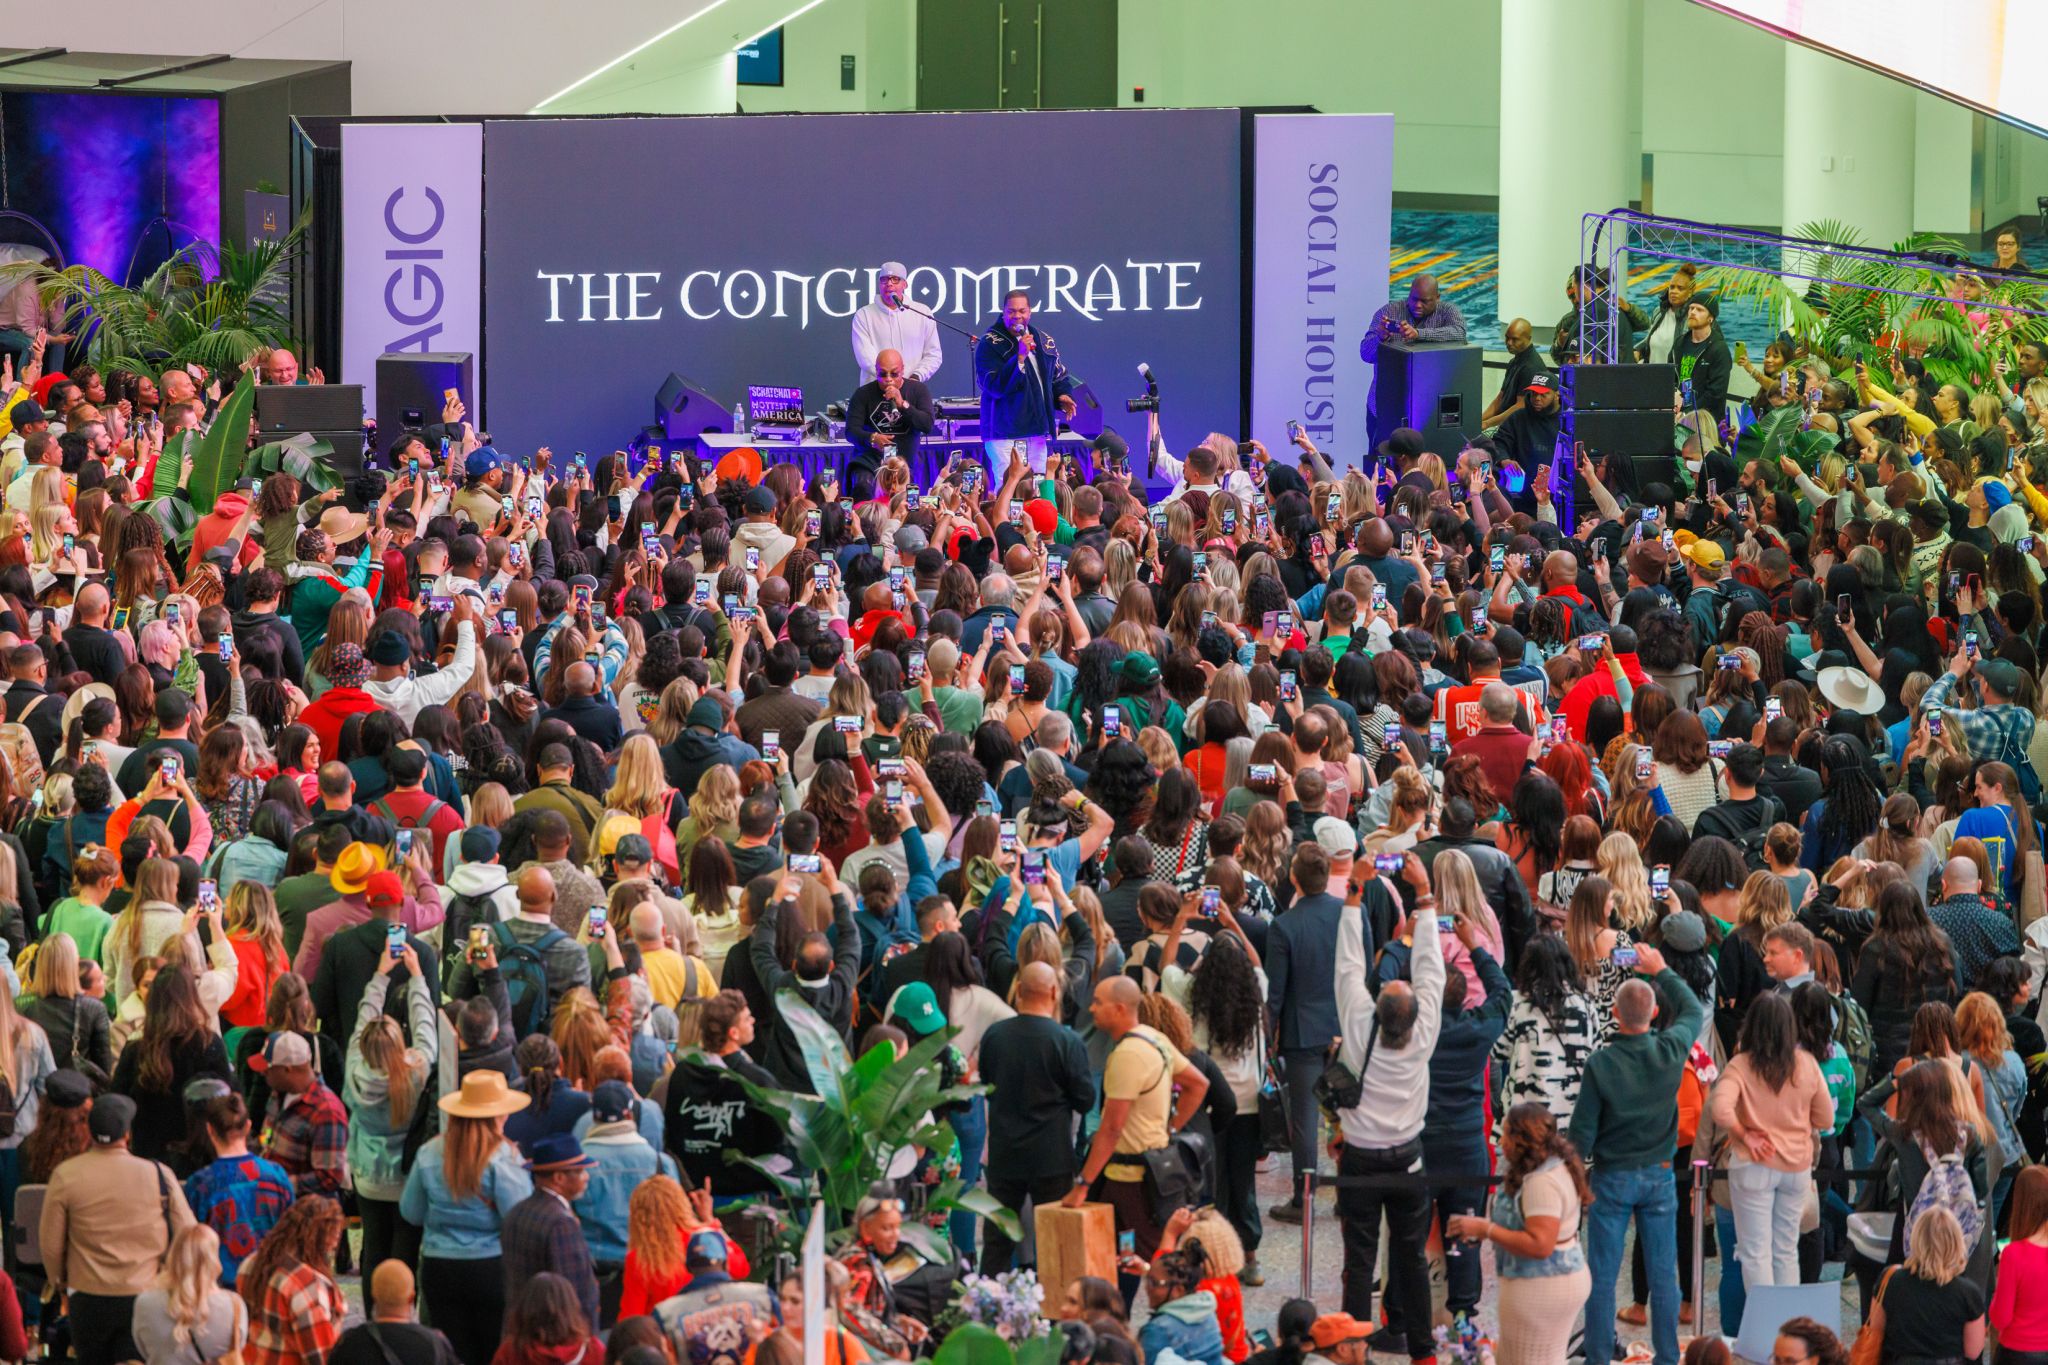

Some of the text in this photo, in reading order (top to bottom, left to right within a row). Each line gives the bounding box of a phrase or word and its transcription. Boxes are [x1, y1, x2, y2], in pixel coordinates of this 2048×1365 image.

[1307, 163, 1339, 304] SOCIAL
[537, 268, 662, 322] THE
[751, 401, 788, 410] HOTTEST
[752, 409, 803, 421] AMERICA
